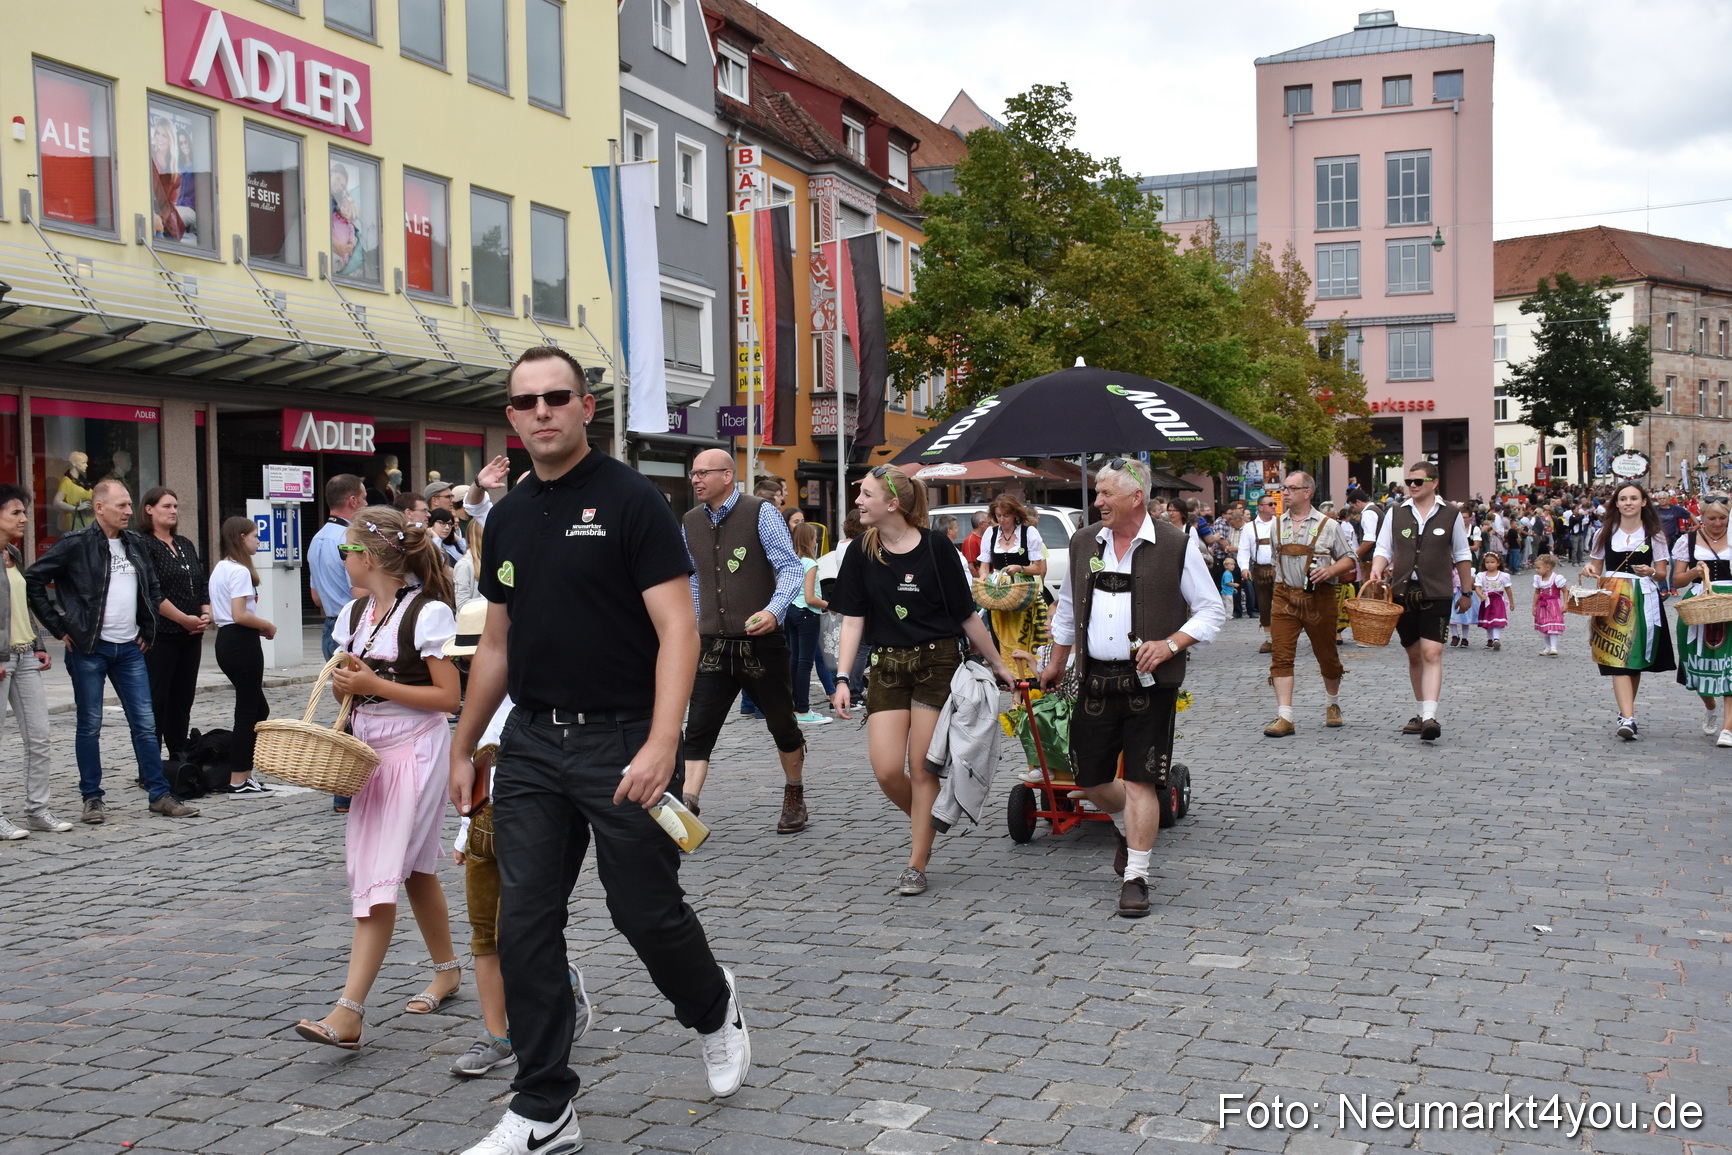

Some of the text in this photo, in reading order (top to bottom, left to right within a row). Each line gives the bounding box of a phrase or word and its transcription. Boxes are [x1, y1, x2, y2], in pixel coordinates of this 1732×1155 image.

[189, 9, 364, 132] ADLER
[257, 188, 280, 205] SEITE
[739, 349, 761, 362] caé
[134, 409, 156, 419] ADLER
[721, 413, 758, 428] libery
[292, 411, 376, 453] ADLER
[276, 509, 296, 519] HIR
[257, 519, 268, 537] P
[565, 528, 607, 537] Lammsbräu
